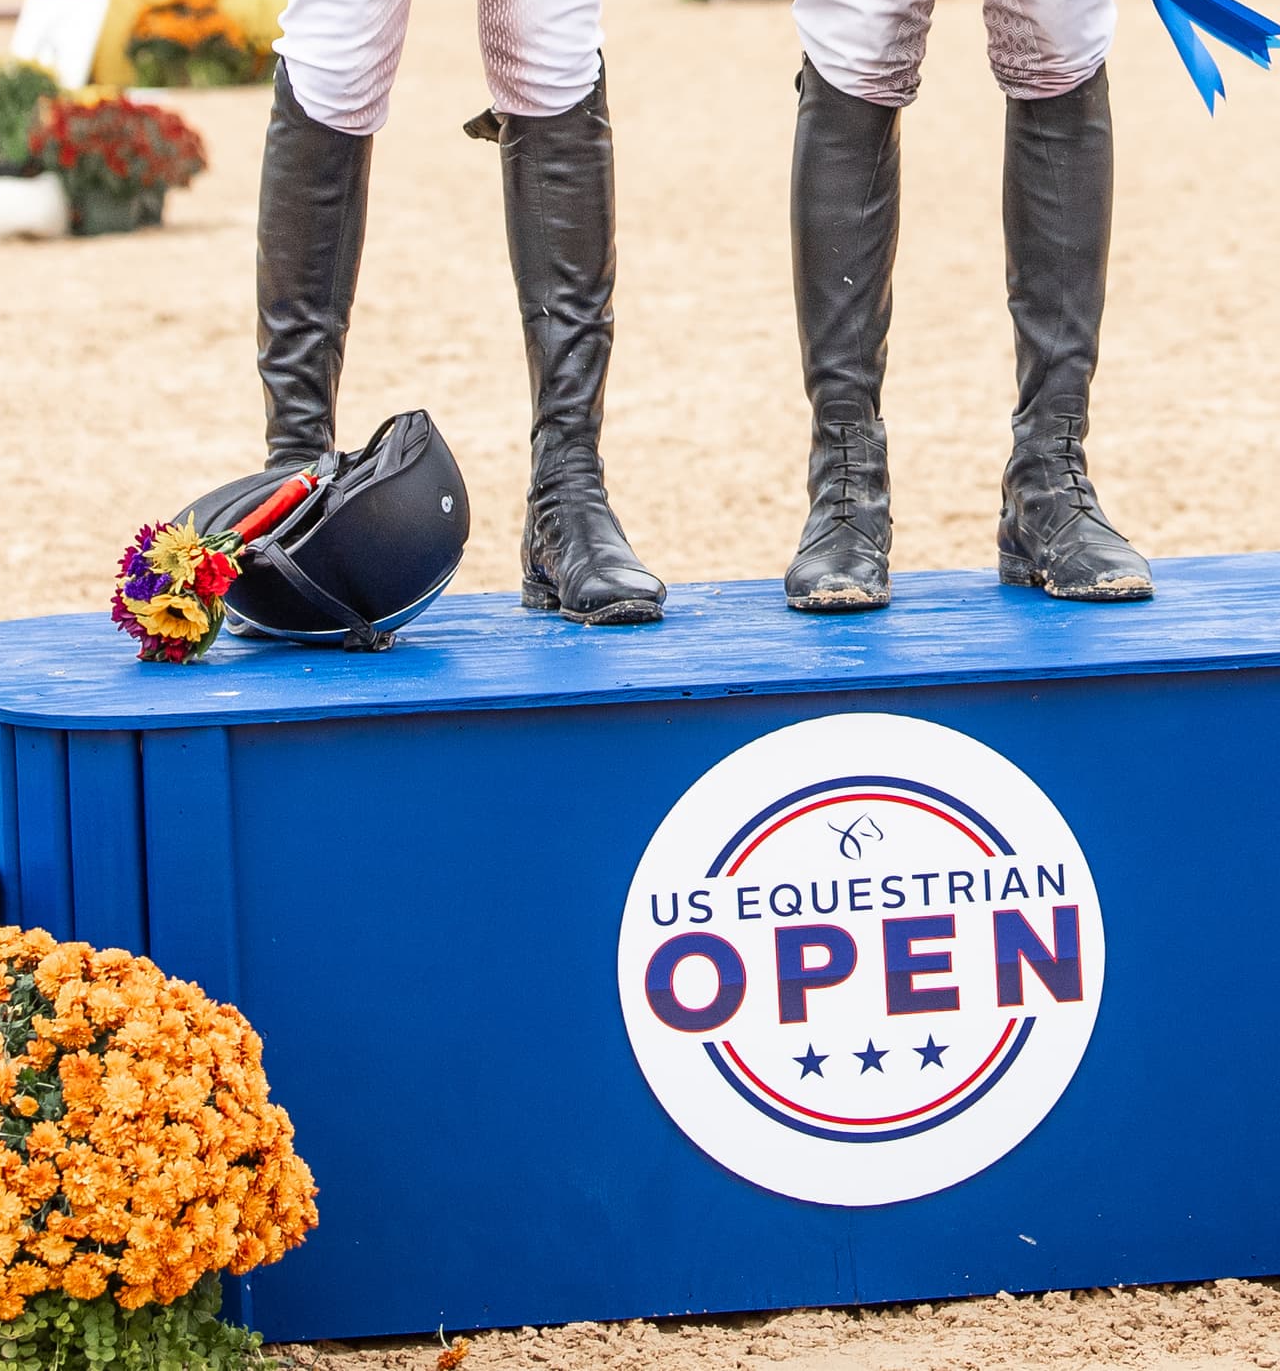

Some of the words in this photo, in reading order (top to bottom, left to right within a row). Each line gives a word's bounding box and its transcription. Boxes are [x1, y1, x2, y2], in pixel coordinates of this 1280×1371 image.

[651, 889, 714, 926] US
[736, 863, 1067, 920] EQUESTRIAN
[644, 904, 1085, 1033] OPEN
